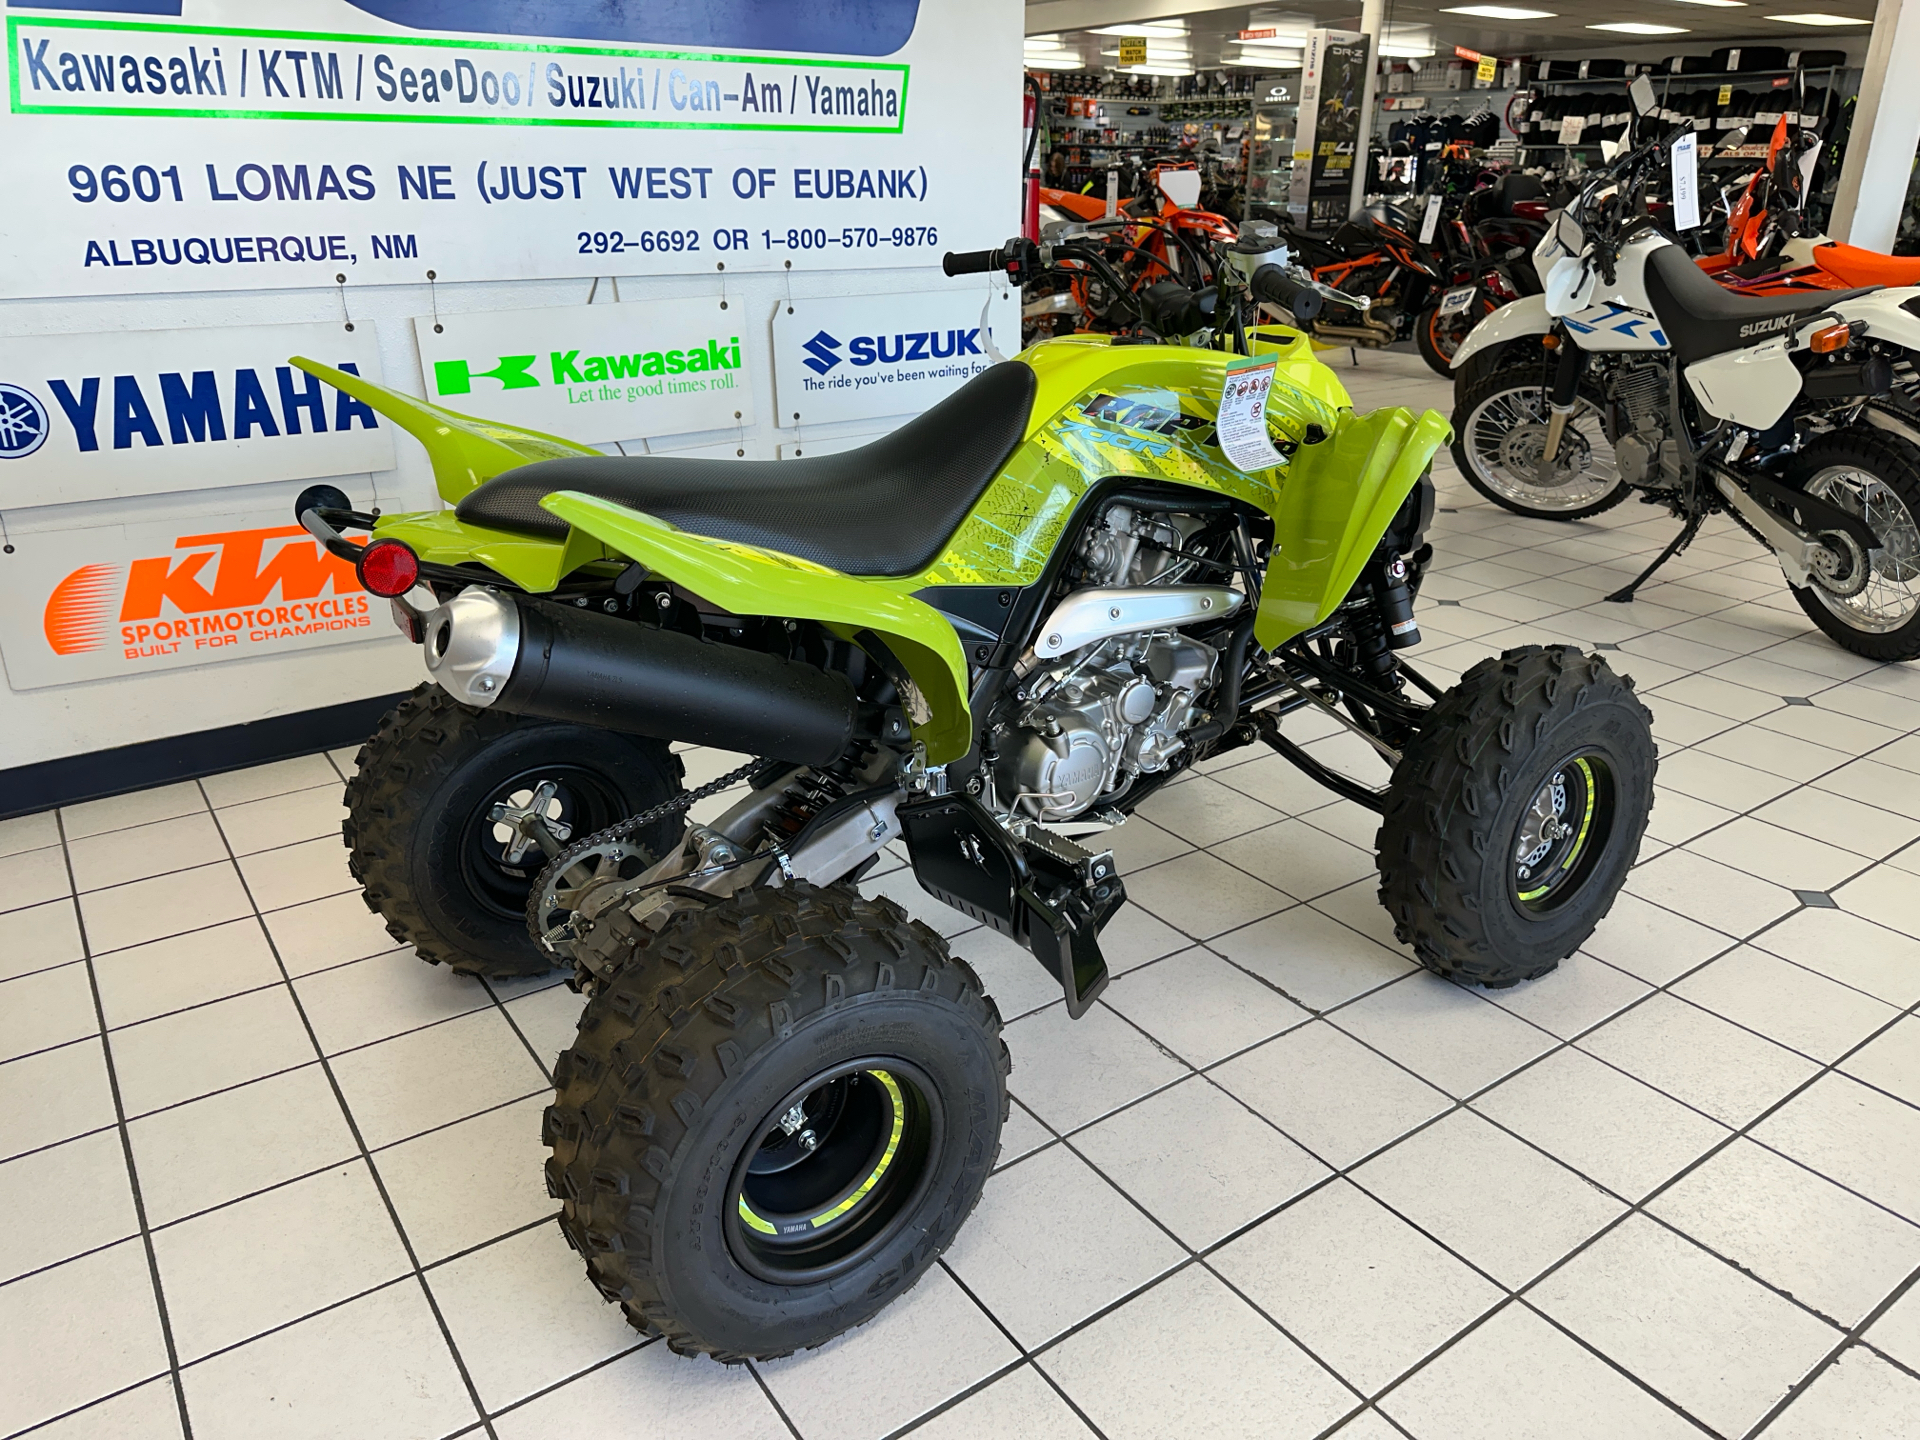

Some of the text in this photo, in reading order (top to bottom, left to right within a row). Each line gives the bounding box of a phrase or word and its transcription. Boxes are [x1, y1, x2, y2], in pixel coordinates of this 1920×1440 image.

[1121, 38, 1146, 46] NOTICE
[23, 38, 227, 96] Kawasaki
[259, 49, 344, 100] KTM
[546, 62, 645, 110] Suzuki
[668, 68, 783, 113] Can-Am
[805, 75, 898, 117] Yamaha
[68, 160, 928, 204] 9601 LOMAS NE (JUST WEST OF EUBANK)
[84, 234, 418, 268] ALBUQUERQUE, NM
[577, 226, 938, 254] 292-6692 OR 1-800-570-9876
[1740, 313, 1796, 338] SUZUKI
[550, 336, 742, 386] Kawasaki
[803, 362, 988, 391] The ride you've been waiting for
[47, 362, 379, 452] YAMAHA
[567, 373, 739, 404] Let the good times roll.
[1057, 419, 1174, 456] 700R
[119, 524, 369, 622] KTM
[121, 595, 369, 645] SPORTMOTORCYCLES
[124, 616, 371, 660] BUILT FOR CHAMPIONS
[1057, 764, 1099, 788] YAMAHA
[866, 1086, 987, 1301] MAXXIS
[783, 1223, 807, 1234] YAMAHA
